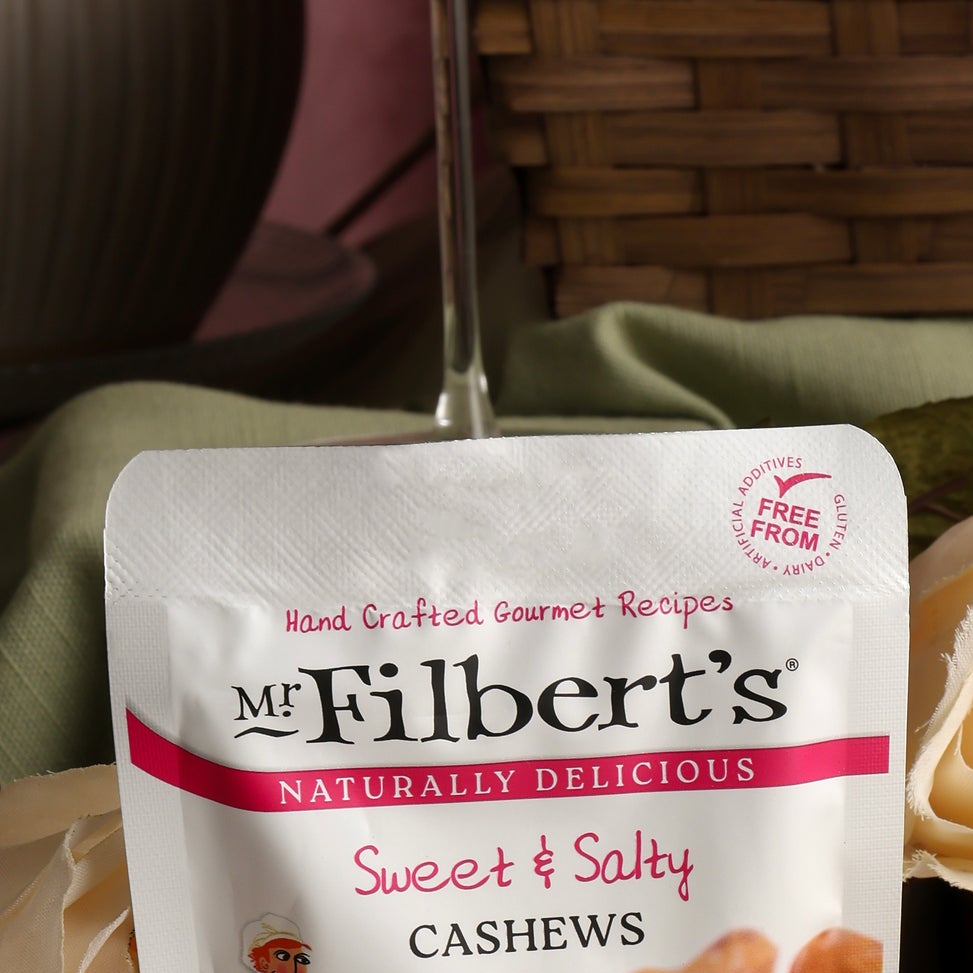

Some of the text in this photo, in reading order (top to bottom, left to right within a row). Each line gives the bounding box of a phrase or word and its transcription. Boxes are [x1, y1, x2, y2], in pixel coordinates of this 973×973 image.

[732, 457, 803, 569] ARTIFICIAL ADDITIVES
[750, 519, 820, 552] FROM
[757, 497, 821, 529] FREE
[783, 494, 848, 576] GLUTEN DAIRY
[285, 590, 734, 633] Hand Crafted Gourmet Recipes
[279, 757, 758, 806] NATURALLY DELICIOUS
[354, 829, 694, 901] Sweet & Salty
[408, 911, 646, 959] CASHEWS
